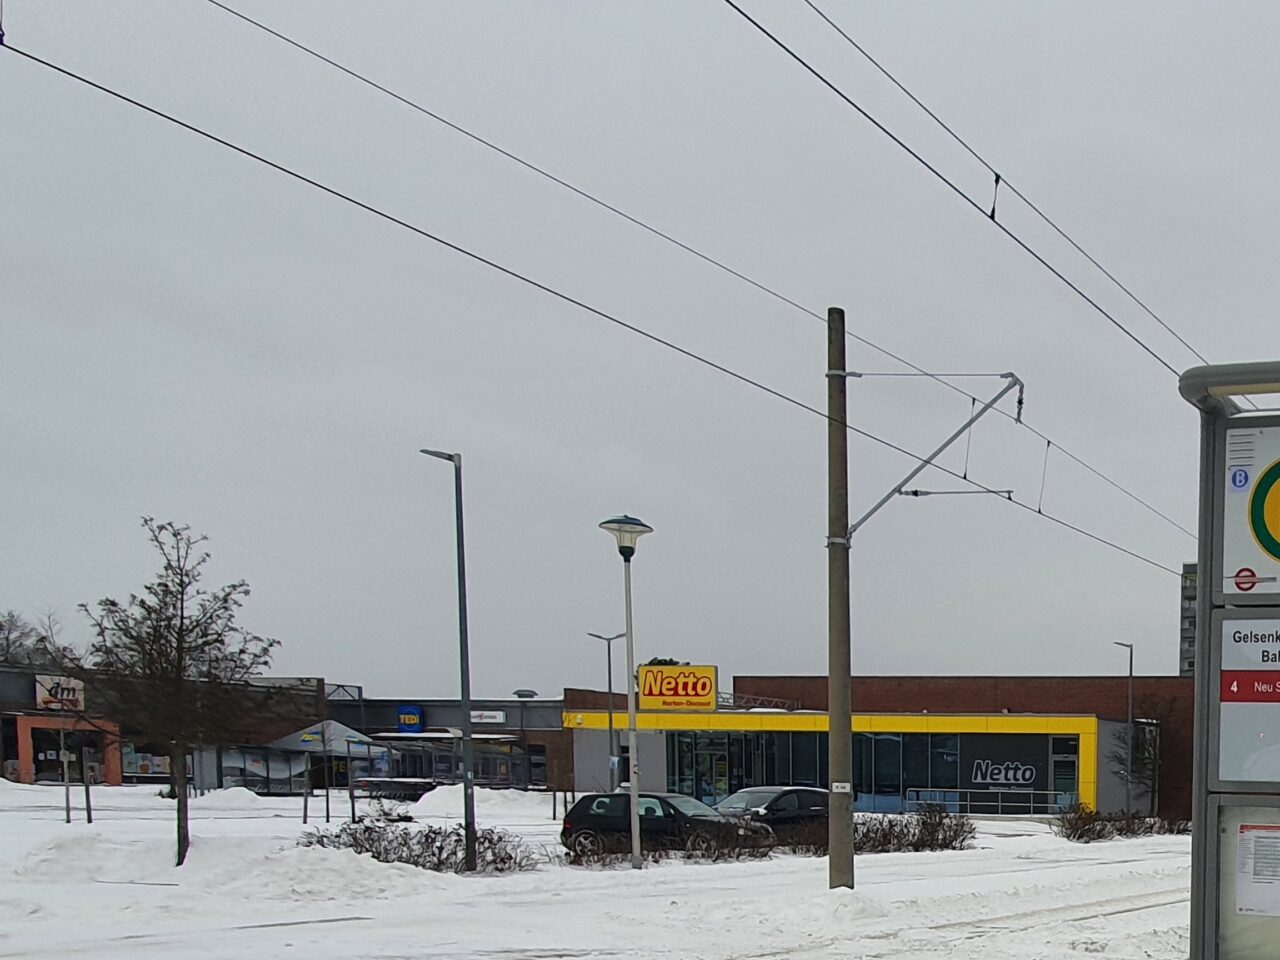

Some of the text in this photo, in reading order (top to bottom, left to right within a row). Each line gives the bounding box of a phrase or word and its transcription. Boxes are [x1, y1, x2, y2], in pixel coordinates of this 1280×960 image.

[49, 682, 77, 699] dm
[643, 670, 712, 696] Netto
[1230, 681, 1238, 692] 4
[1254, 681, 1273, 692] Neu
[972, 760, 1036, 784] Netto
